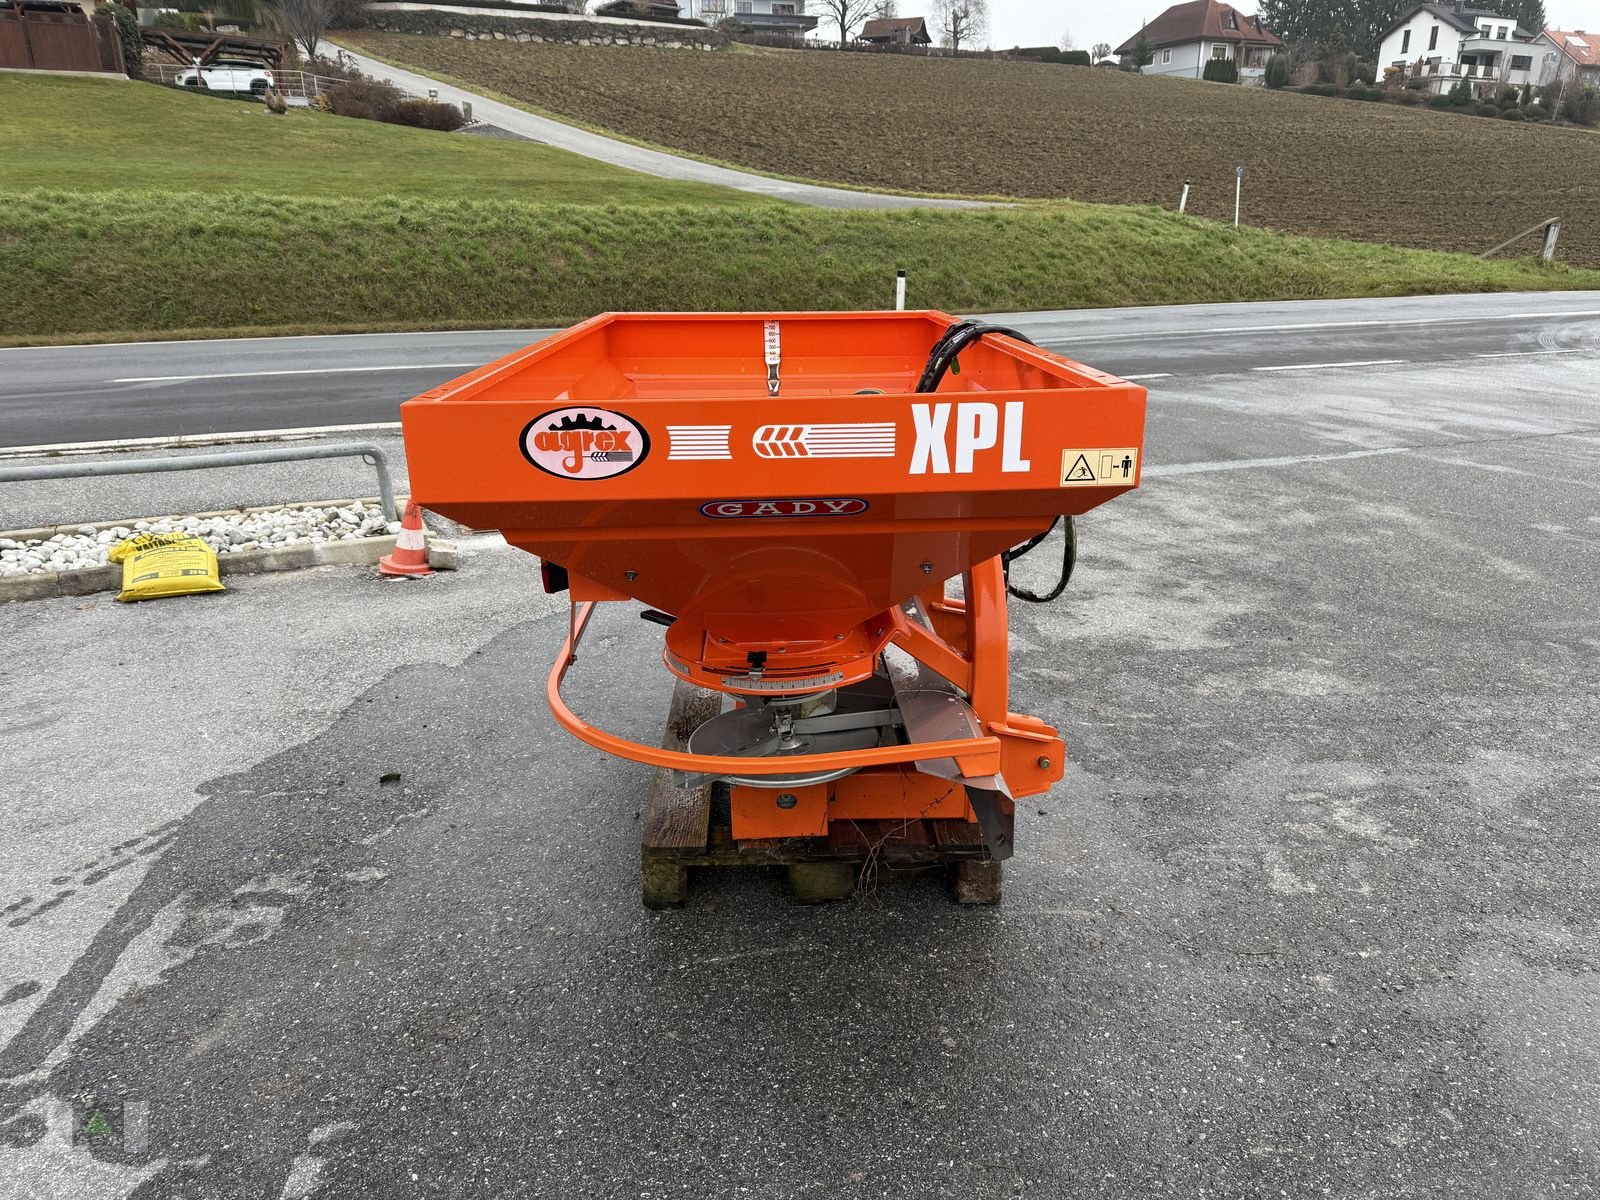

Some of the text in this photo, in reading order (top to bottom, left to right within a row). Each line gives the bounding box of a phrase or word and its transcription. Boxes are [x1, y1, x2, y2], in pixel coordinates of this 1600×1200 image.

[534, 430, 633, 474] agrex
[909, 401, 1031, 474] XPL
[717, 500, 852, 516] GADY
